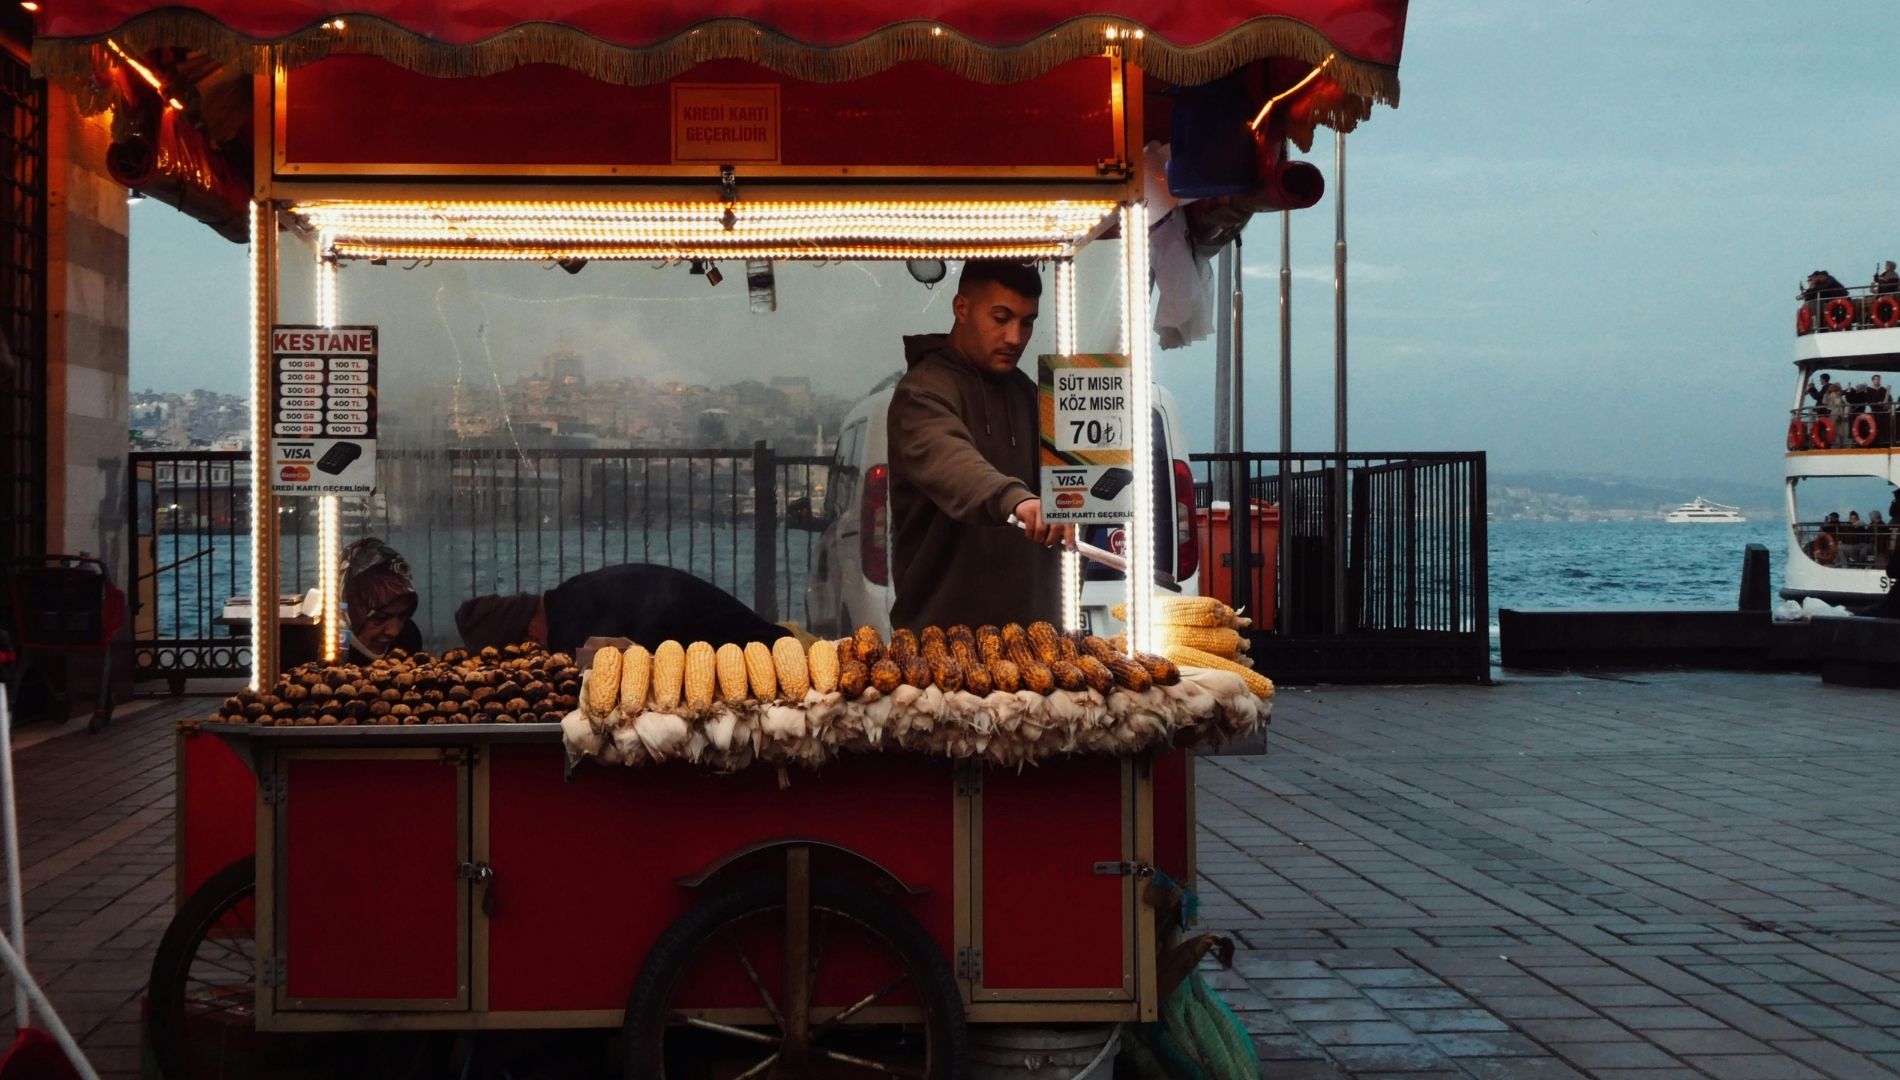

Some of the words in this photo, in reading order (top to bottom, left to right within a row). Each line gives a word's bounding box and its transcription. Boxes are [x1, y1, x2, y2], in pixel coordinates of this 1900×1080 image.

[683, 104, 724, 121] KREDİ
[729, 106, 769, 121] KARTI
[686, 124, 767, 145] GEÇERLİDİR
[274, 333, 372, 351] KESTANE
[1059, 374, 1084, 391] SÜT
[1088, 377, 1123, 391] MISIR
[1059, 394, 1086, 411] KÖZ
[1089, 396, 1124, 411] MISIR
[281, 425, 302, 433] 1000
[303, 425, 314, 433] GR
[283, 449, 311, 459] VISA
[1056, 475, 1085, 486] VISA
[323, 484, 370, 493] GEÇERLİDİR
[1046, 511, 1070, 519] KREDİ
